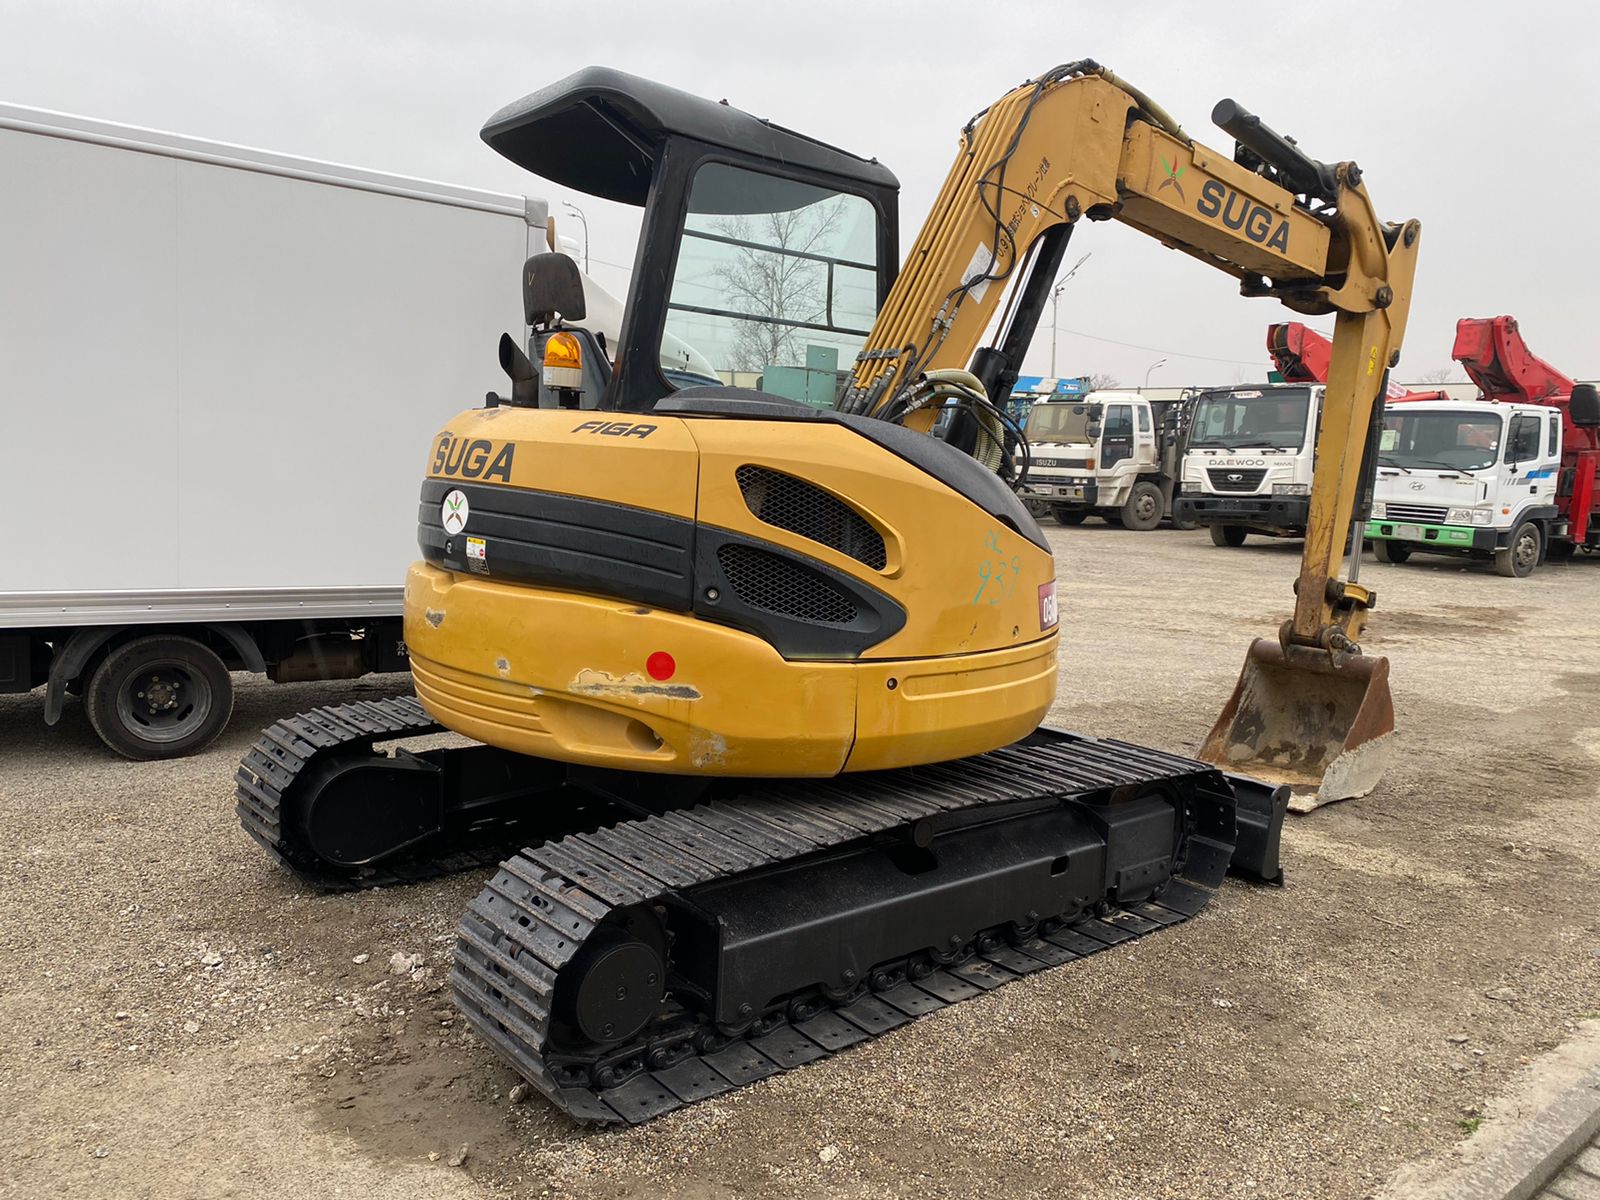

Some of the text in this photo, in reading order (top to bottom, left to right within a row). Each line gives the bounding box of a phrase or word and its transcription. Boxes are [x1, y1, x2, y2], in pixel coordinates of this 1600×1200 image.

[1197, 180, 1289, 254] SUGA
[571, 421, 658, 439] FIGA
[432, 437, 515, 483] SUGA
[1036, 459, 1057, 467] ISUZU
